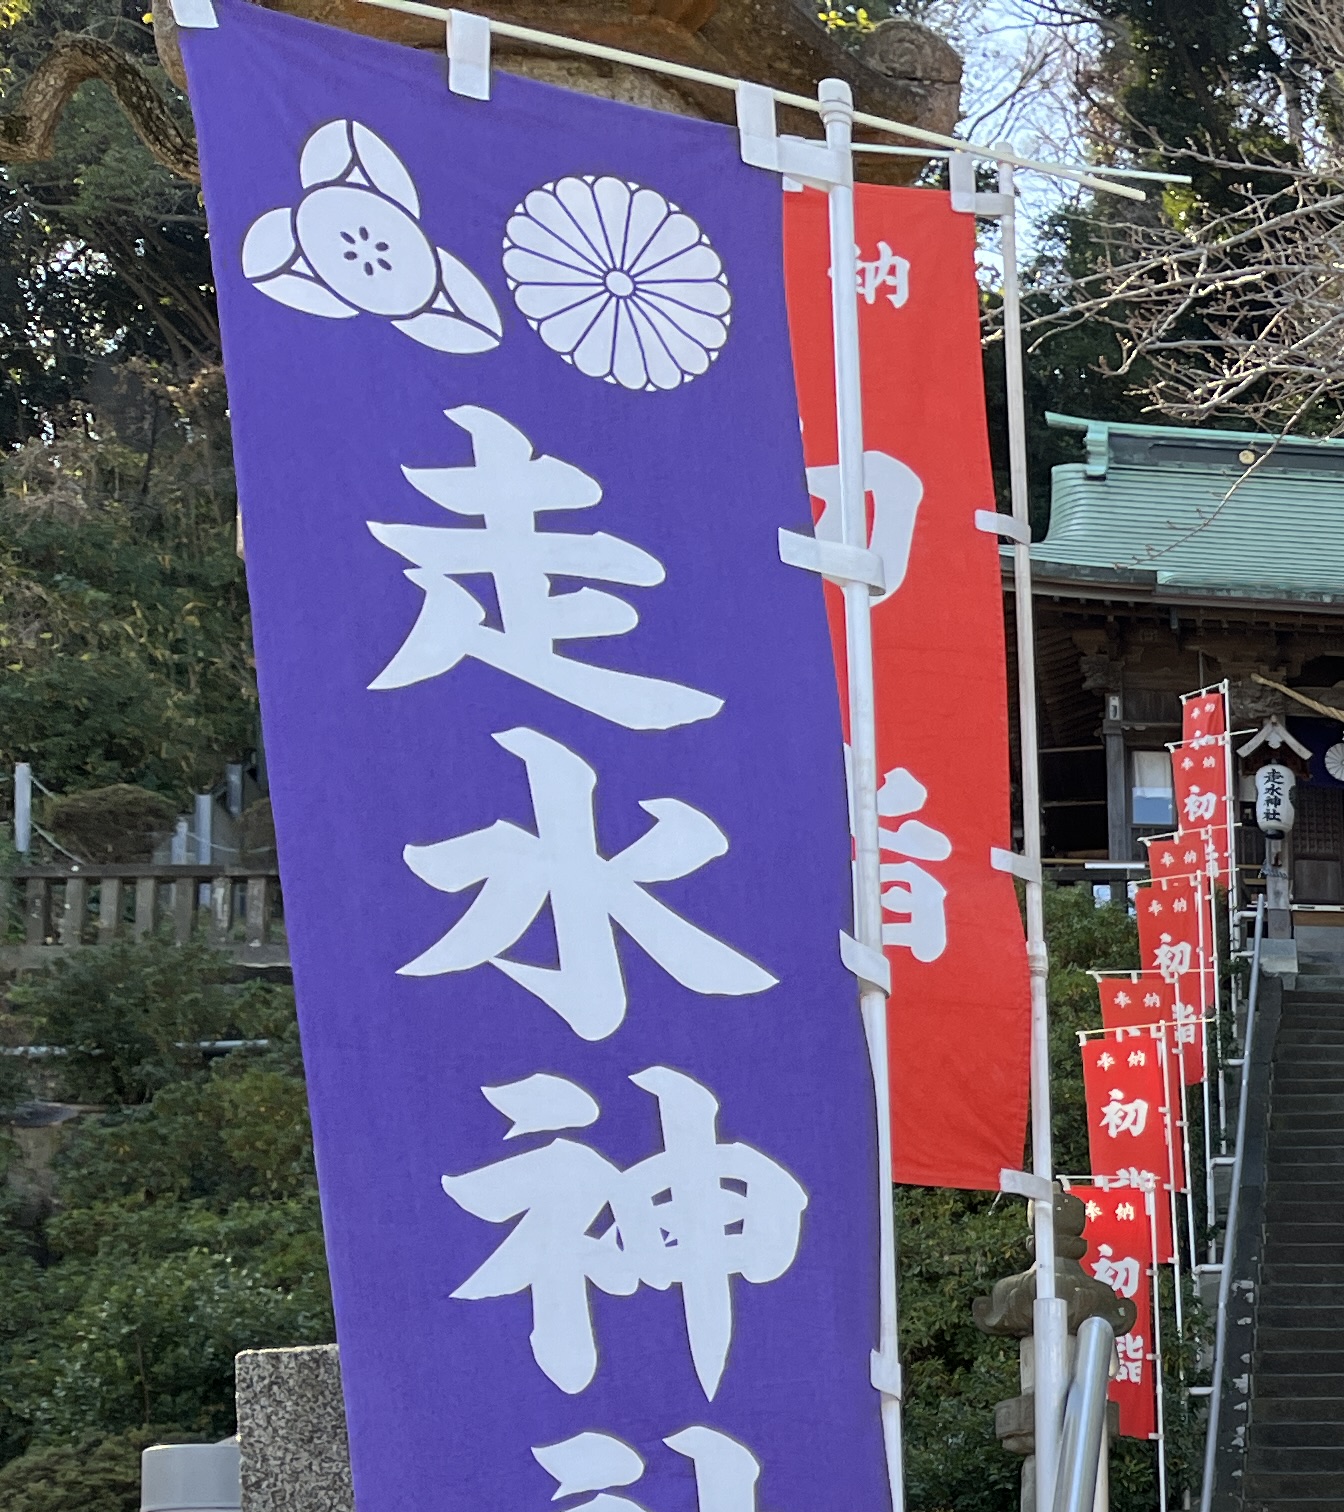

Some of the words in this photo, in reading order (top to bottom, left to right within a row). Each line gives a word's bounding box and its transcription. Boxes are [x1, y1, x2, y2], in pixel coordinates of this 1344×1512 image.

[1262, 767, 1285, 822] 走水神社
[1147, 898, 1187, 917] 奉納
[1113, 991, 1161, 1009] 奉納
[1096, 1050, 1147, 1071] 奉納
